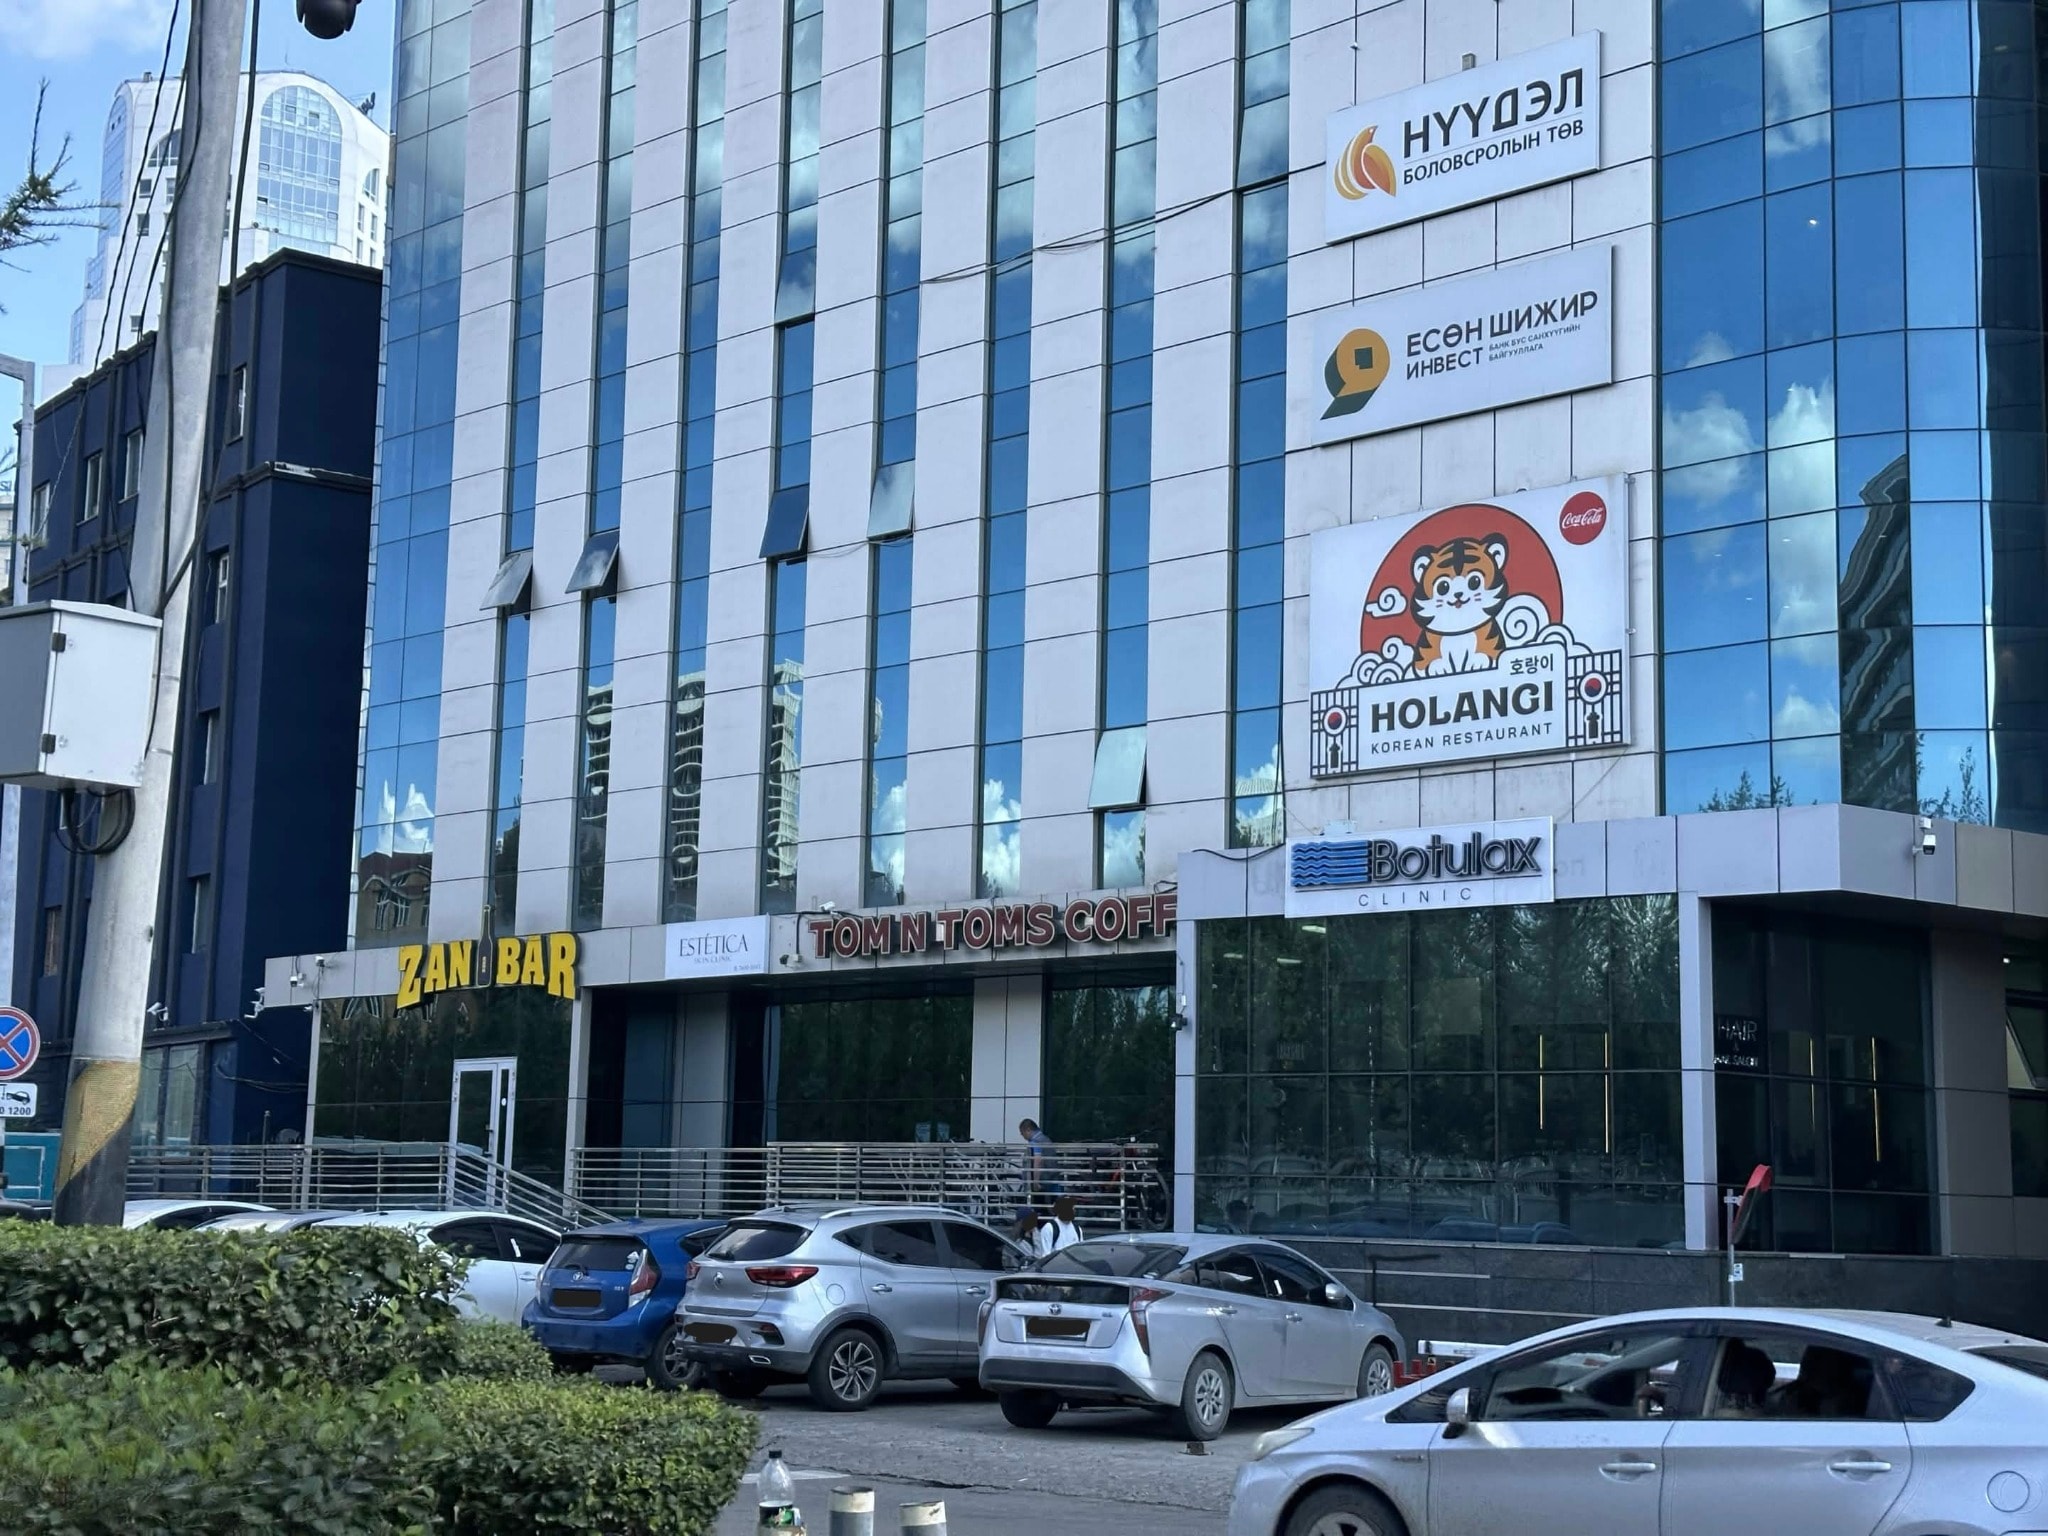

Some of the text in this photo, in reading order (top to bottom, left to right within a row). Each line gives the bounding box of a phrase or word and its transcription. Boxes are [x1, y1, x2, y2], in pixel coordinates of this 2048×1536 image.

[1403, 68, 1583, 158] НҮҮДЭЛ
[1403, 119, 1583, 185] БОЛОВСРОЛЫН ТӨВ
[1406, 290, 1598, 357] ЕСӨН ШИЖИР
[1489, 340, 1510, 352] БАНК
[1511, 336, 1527, 347] БУС
[1406, 347, 1483, 381] ИНВЕСТ
[1509, 653, 1554, 676] 호랑이
[1371, 681, 1554, 733] HOLANGI
[1371, 722, 1552, 755] KOREAN RESTAURANT
[1370, 831, 1543, 882] Botulax
[1358, 887, 1472, 907] CLINIC
[679, 933, 748, 957] ESTÉTICA
[808, 914, 895, 959] TOM
[901, 911, 931, 954] N
[936, 902, 1058, 950] TOMS
[496, 931, 578, 1000] BAR
[8, 1106, 31, 1115] 1200
